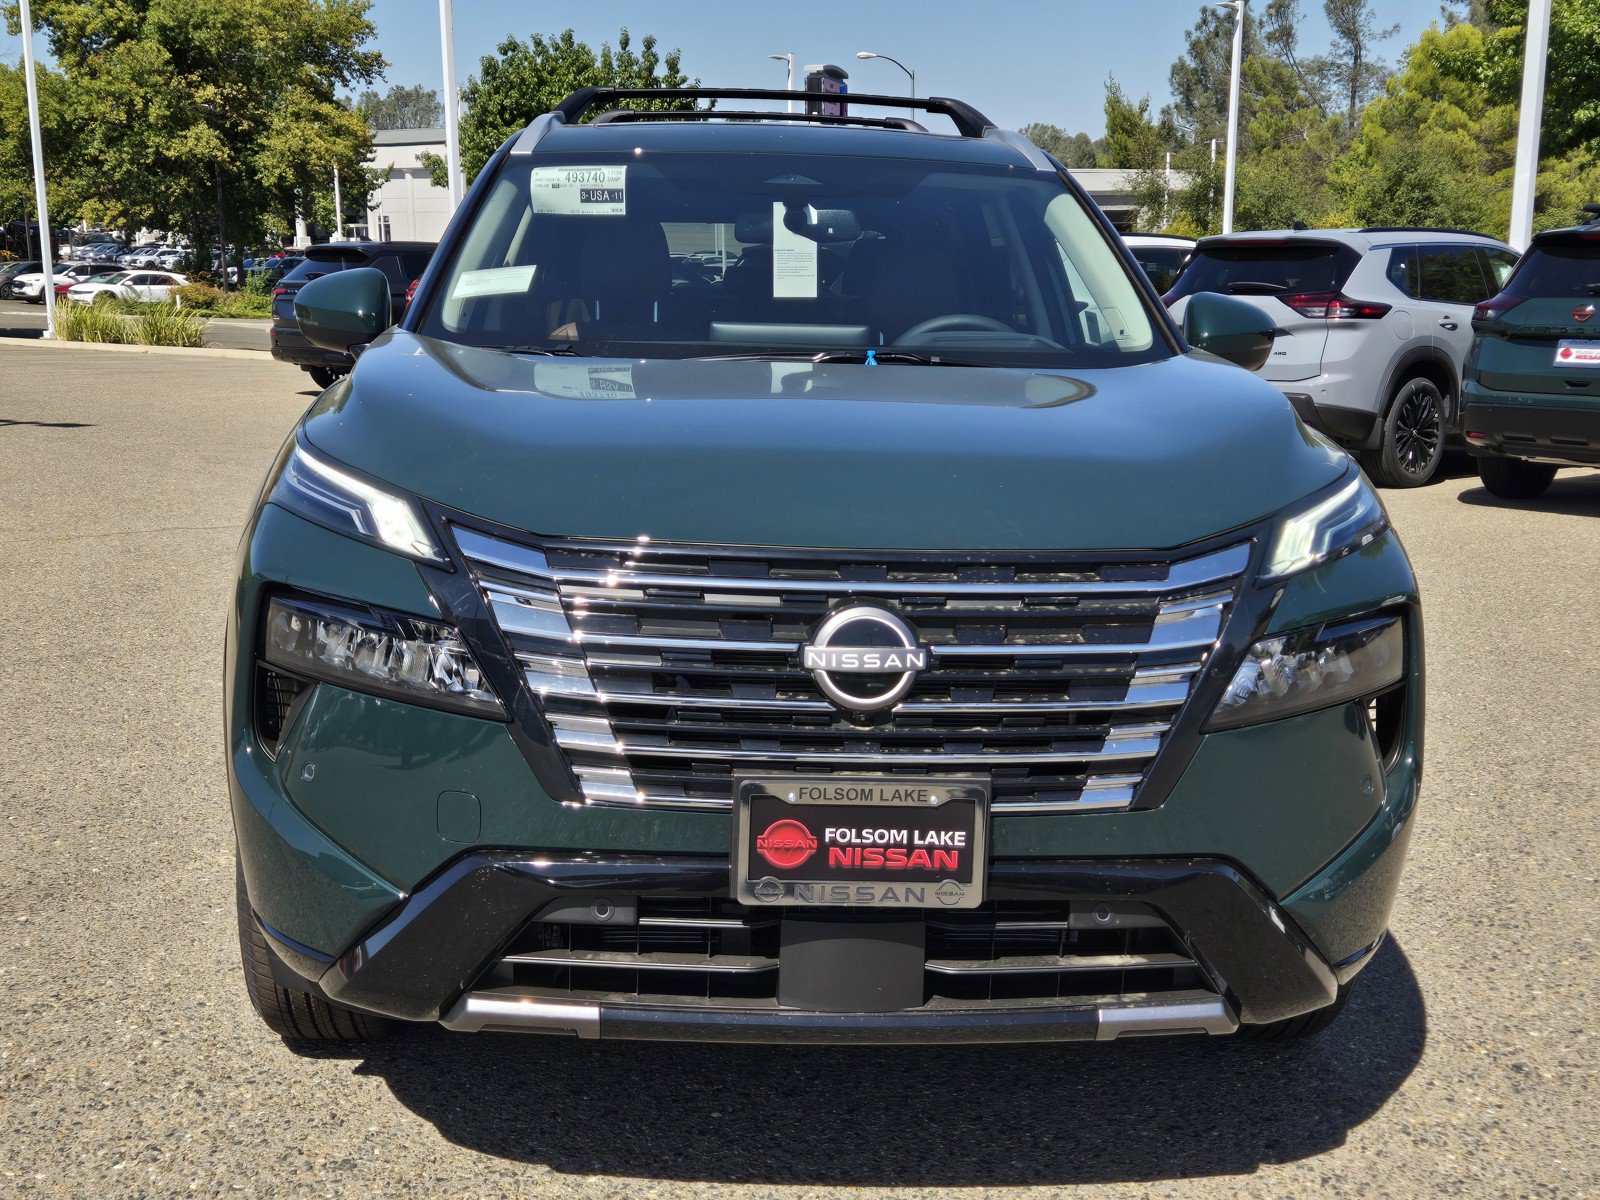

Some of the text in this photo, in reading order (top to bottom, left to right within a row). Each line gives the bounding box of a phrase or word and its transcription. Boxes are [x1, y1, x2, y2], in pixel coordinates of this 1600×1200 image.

[565, 172, 605, 183] 493740
[590, 190, 610, 200] USA
[807, 651, 924, 668] NISSAN
[798, 787, 928, 803] FOLSOM LAKE
[756, 839, 818, 849] NISSAN
[824, 827, 966, 846] FOLSOM LAKE
[828, 847, 959, 870] NISSAN
[794, 883, 925, 903] NISSAN
